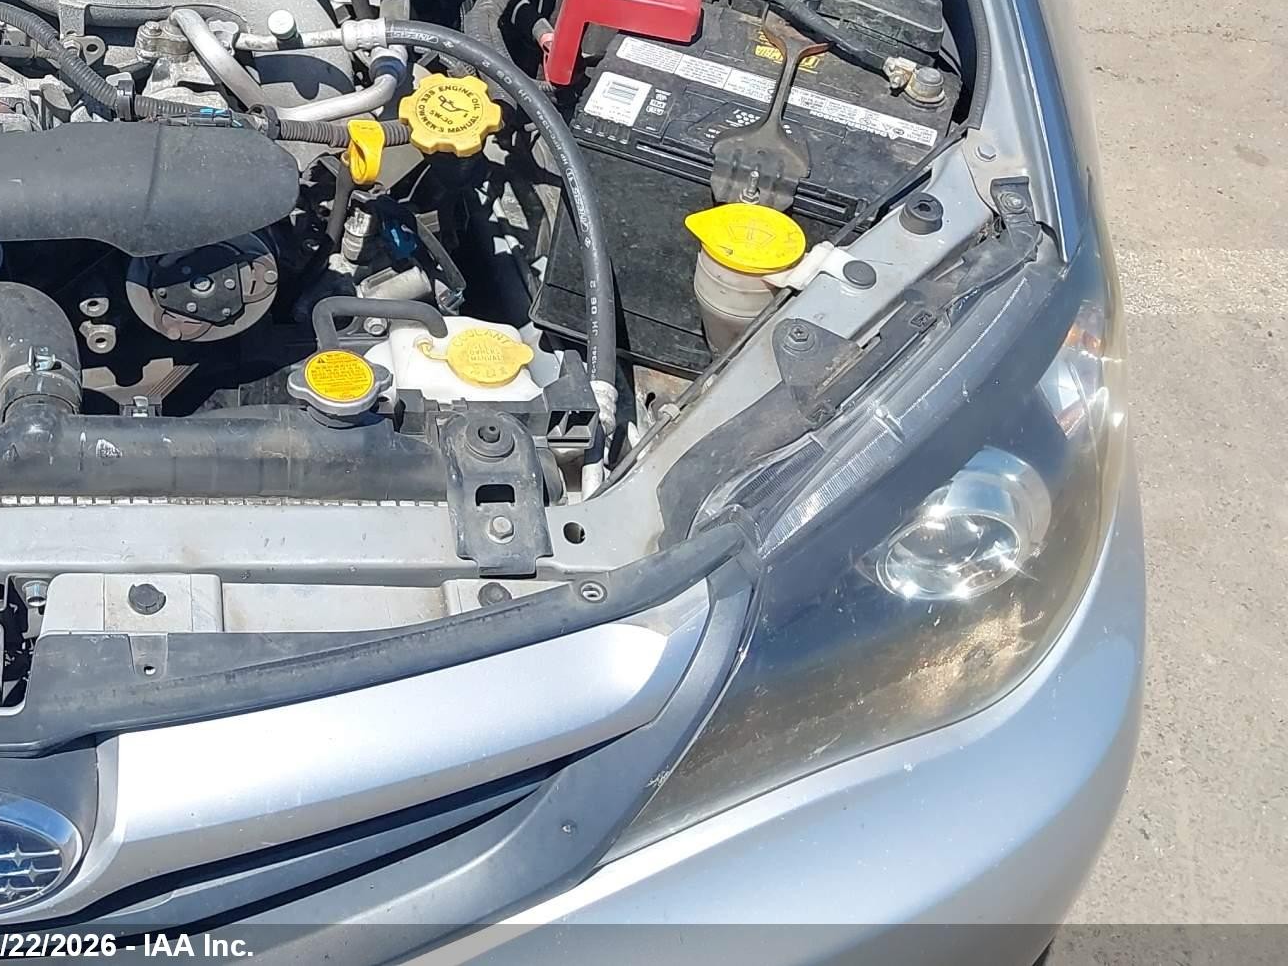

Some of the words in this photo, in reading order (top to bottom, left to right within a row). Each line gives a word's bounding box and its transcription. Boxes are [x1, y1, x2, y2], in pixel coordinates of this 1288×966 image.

[438, 85, 473, 98] ENGINE
[471, 98, 481, 111] OIL
[518, 89, 533, 104] JH
[421, 90, 436, 103] SEE
[447, 115, 479, 133] MANUAL
[429, 109, 454, 125] 5W-30
[810, 110, 887, 138] DANGER/POISON
[591, 321, 599, 336] JH
